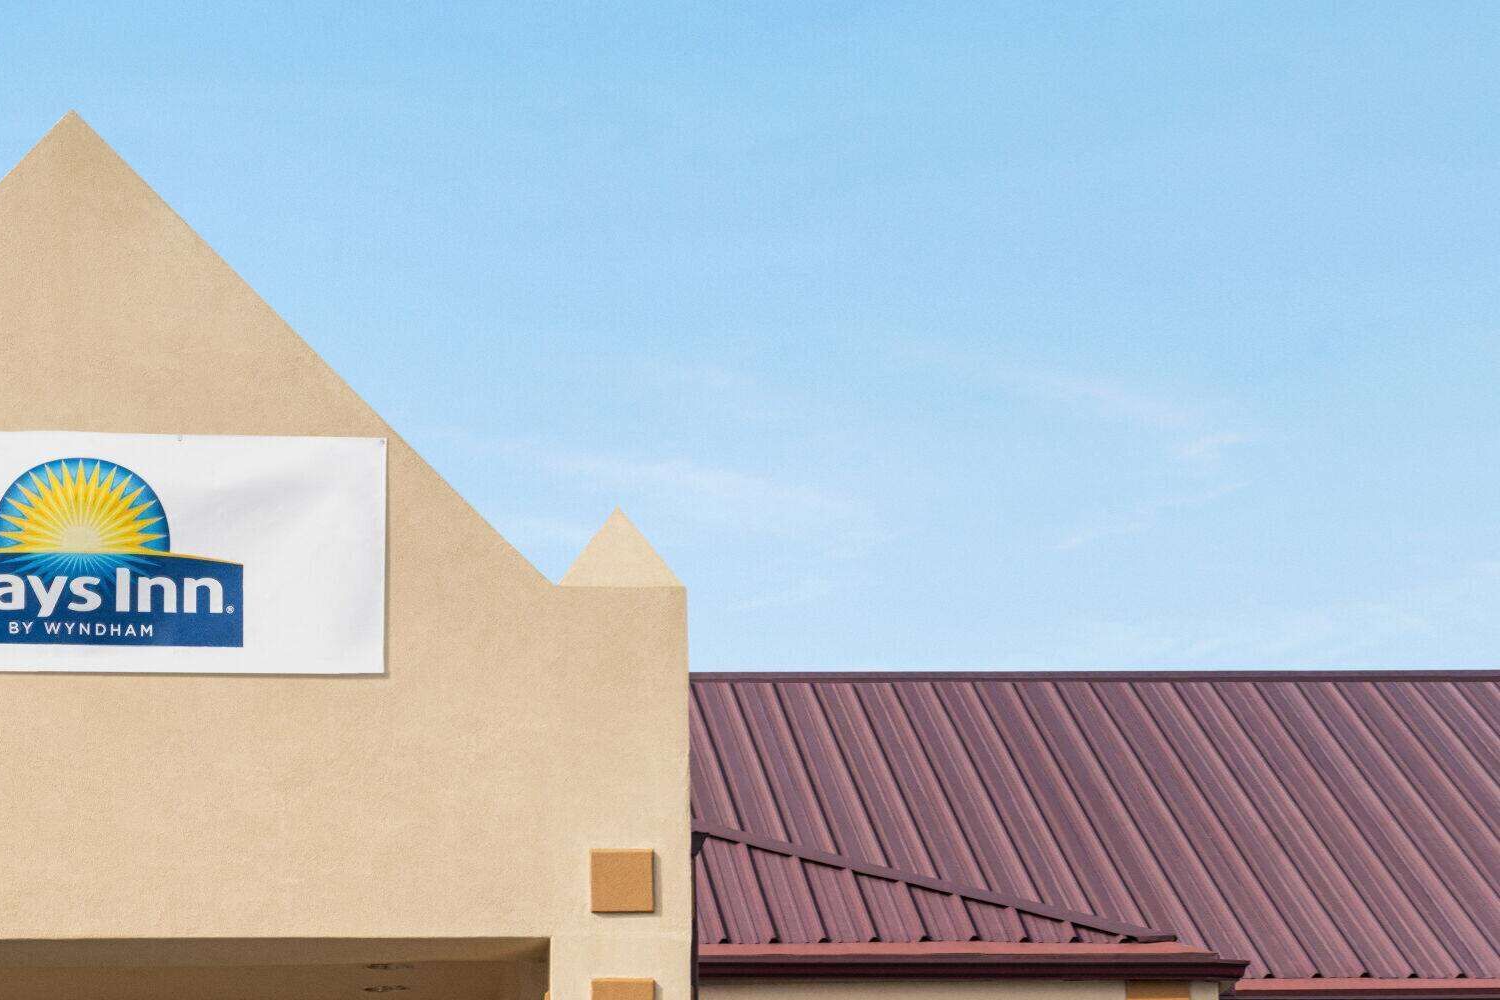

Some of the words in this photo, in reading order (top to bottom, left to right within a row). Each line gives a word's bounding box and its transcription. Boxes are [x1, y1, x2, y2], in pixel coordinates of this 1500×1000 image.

[115, 567, 225, 614] Inn
[8, 621, 34, 635] BY
[44, 622, 154, 638] WYNDHAM
